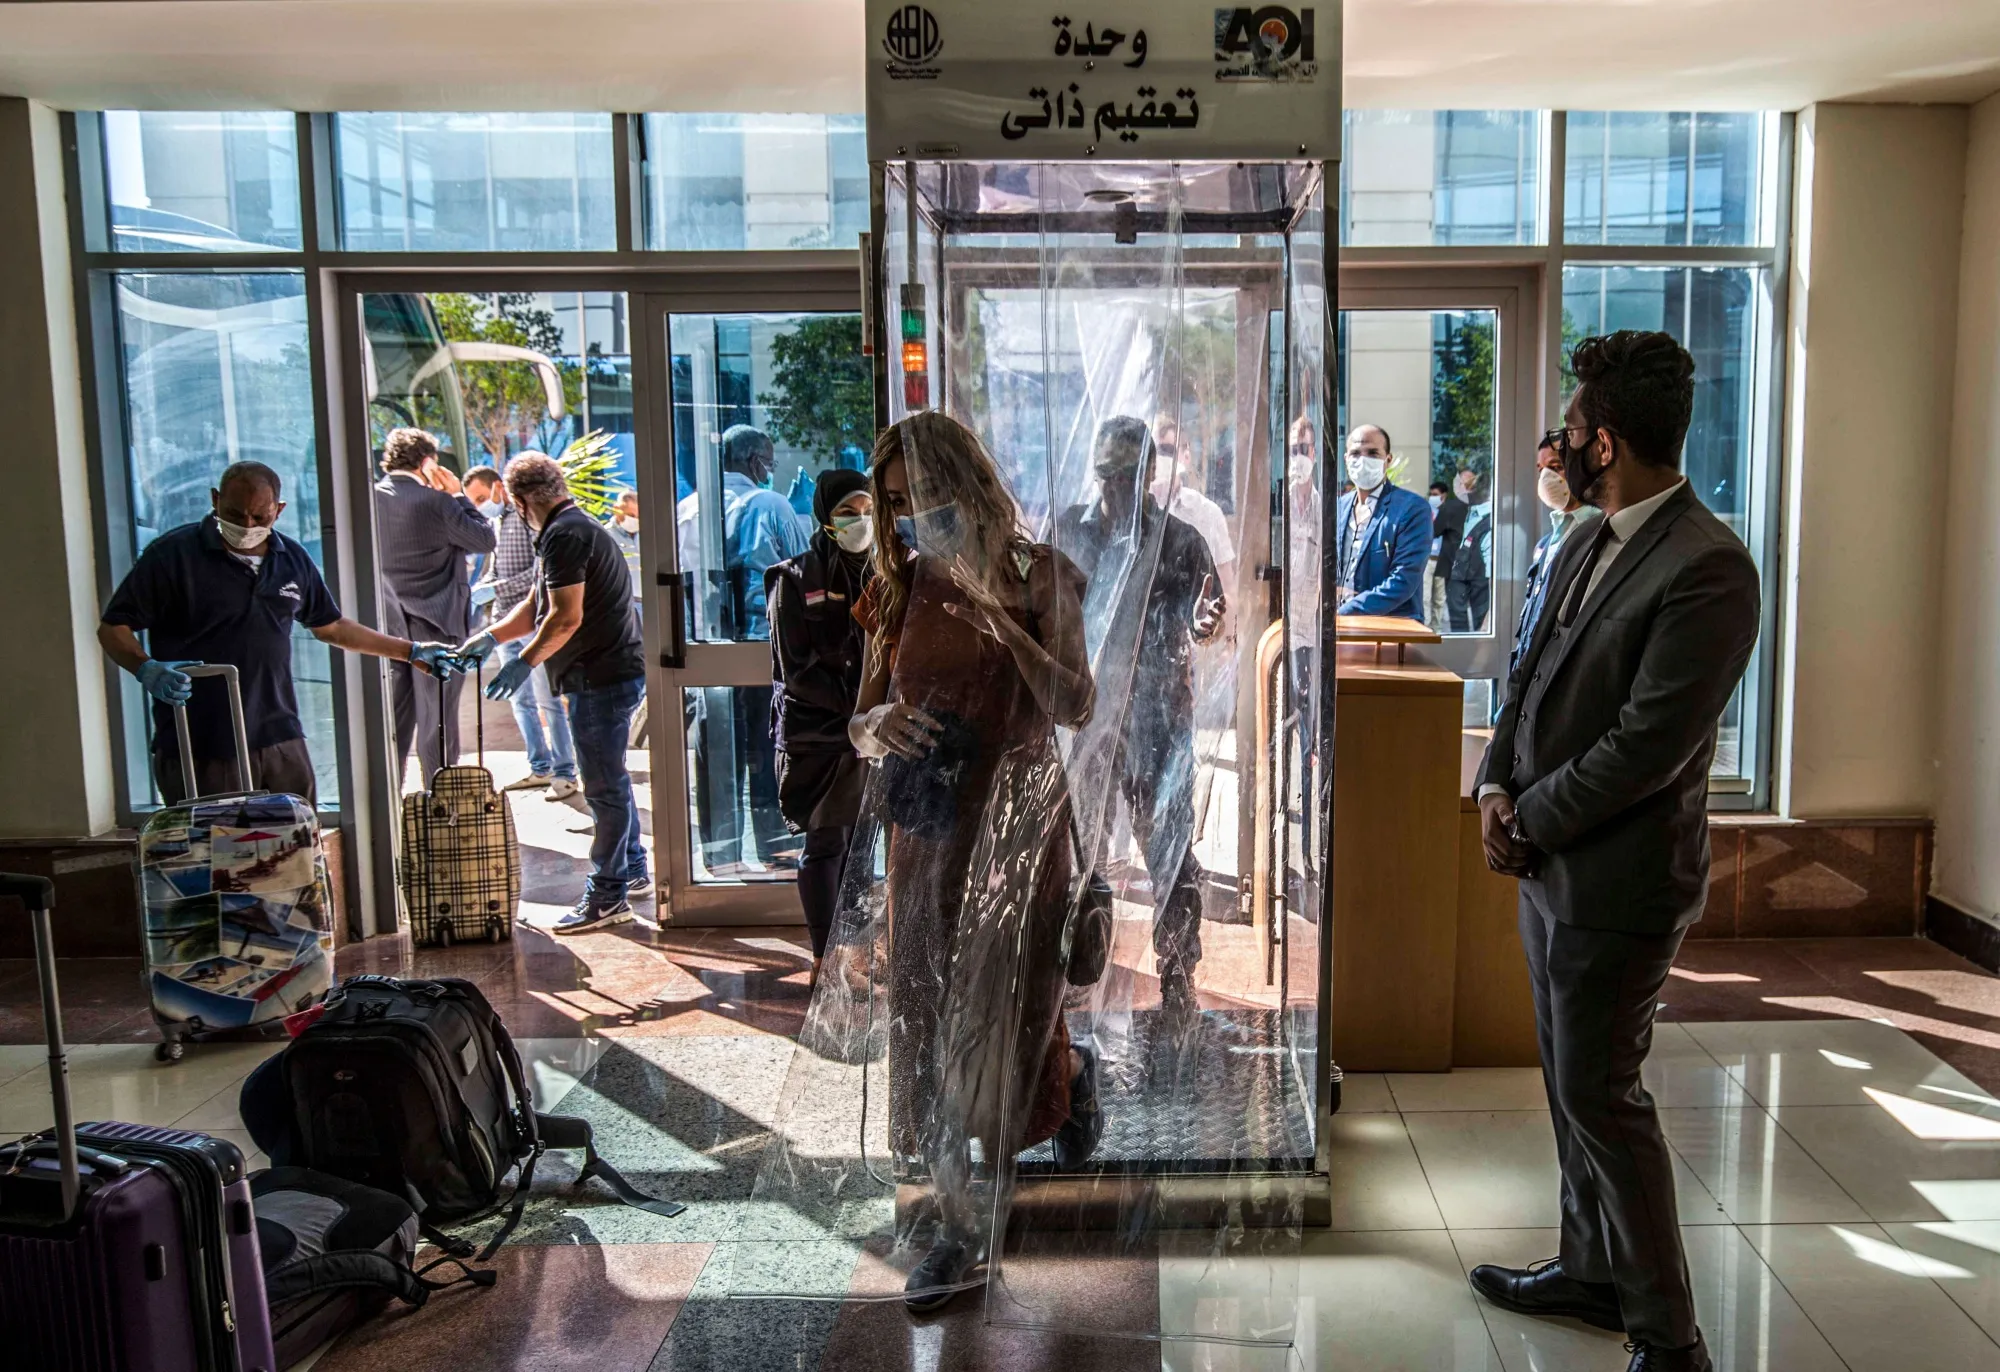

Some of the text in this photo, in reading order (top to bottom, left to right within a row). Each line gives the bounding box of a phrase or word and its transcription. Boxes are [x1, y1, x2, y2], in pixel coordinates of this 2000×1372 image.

[1051, 16, 1148, 69] وحدة
[1221, 5, 1315, 62] AOI
[1093, 86, 1200, 143] تعقيم
